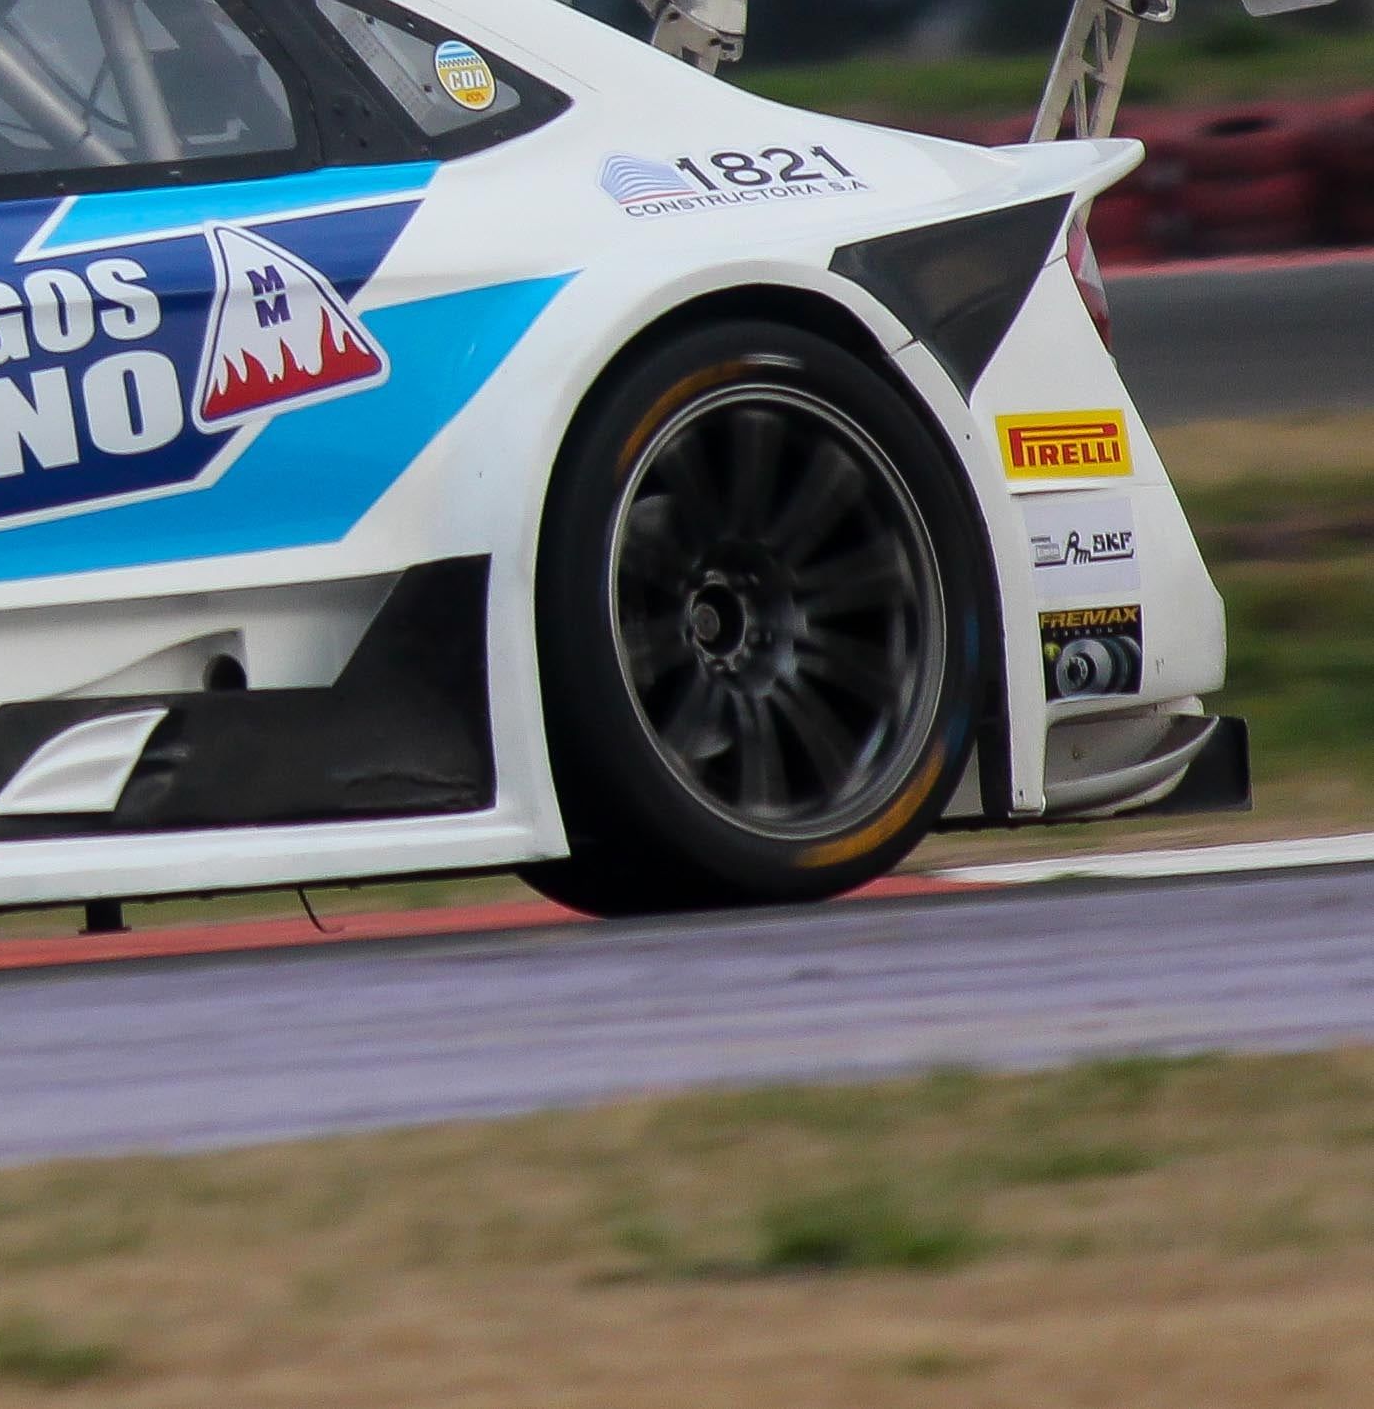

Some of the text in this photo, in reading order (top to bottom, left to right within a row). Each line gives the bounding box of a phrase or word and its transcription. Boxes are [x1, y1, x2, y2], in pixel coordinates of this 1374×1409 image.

[449, 70, 488, 91] CDA
[676, 146, 852, 191] 1821
[625, 183, 822, 218] CONSTRUCTORA
[1008, 423, 1121, 468] PIRELLI
[1040, 606, 1140, 629] FREMAX
